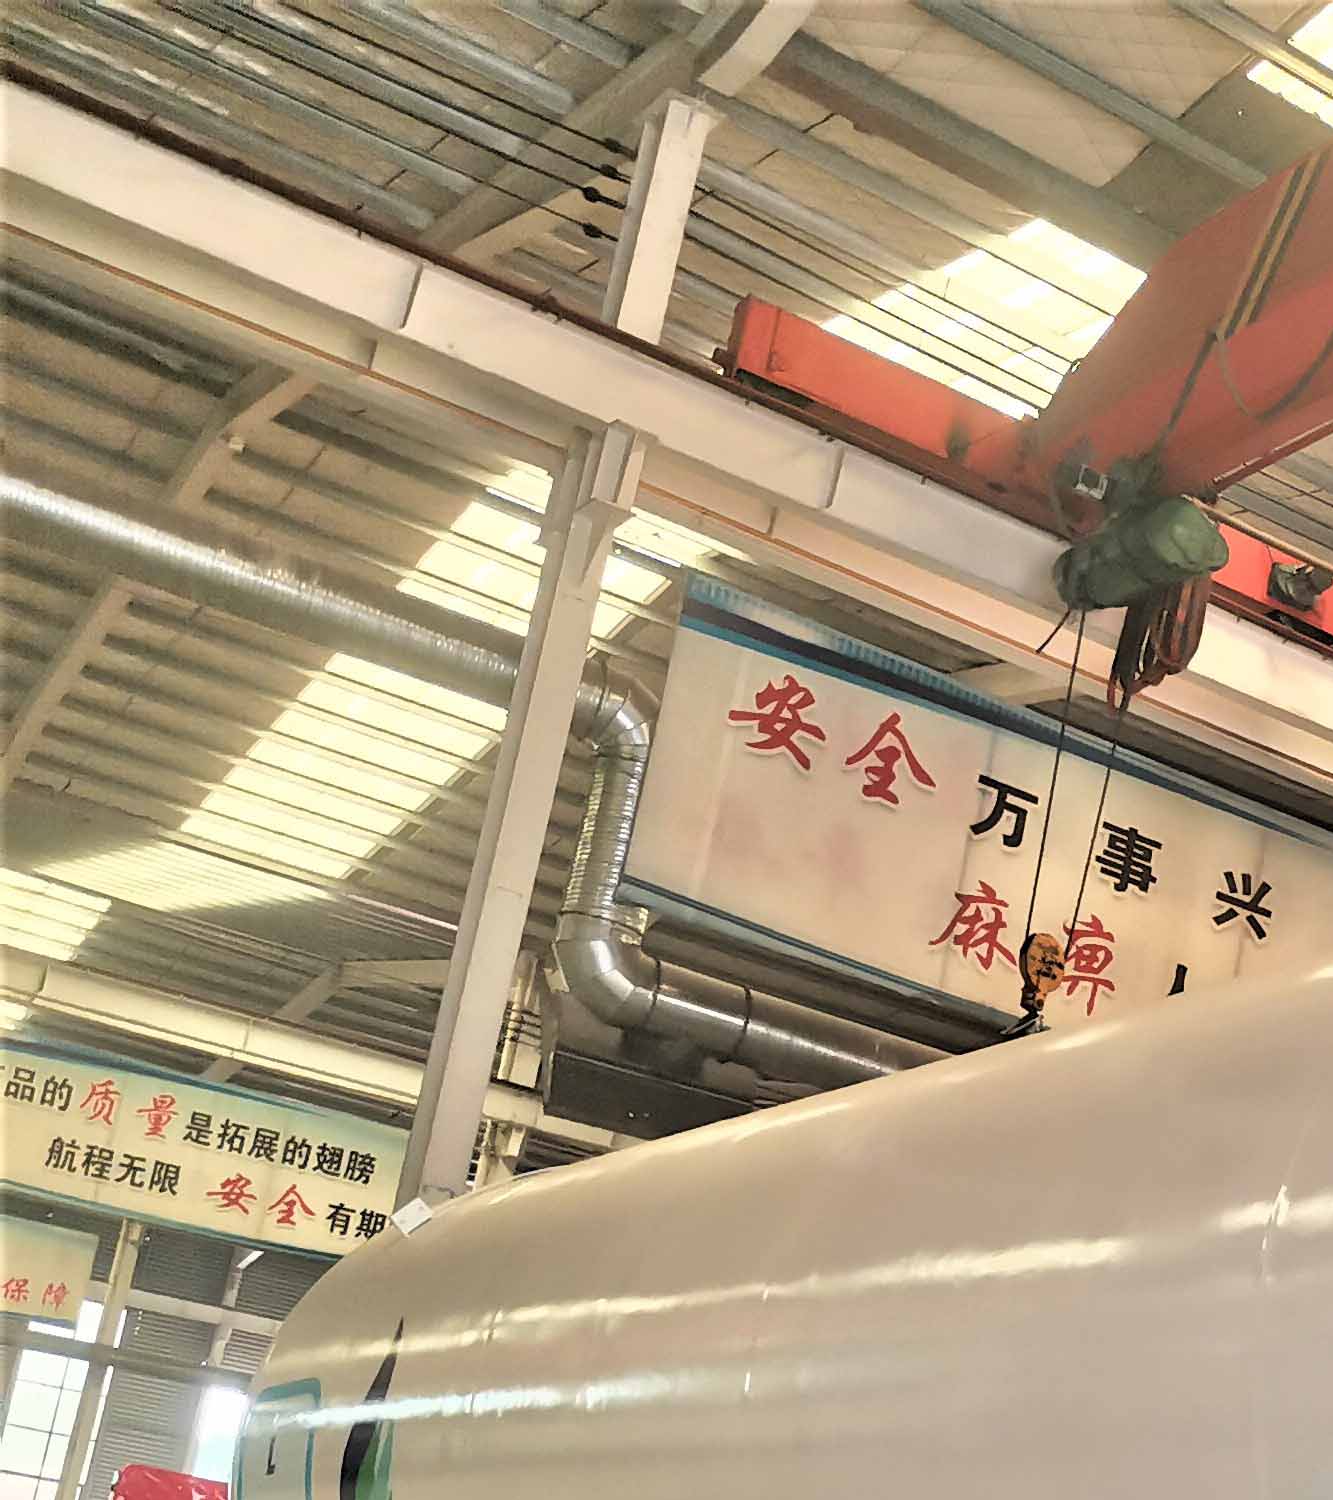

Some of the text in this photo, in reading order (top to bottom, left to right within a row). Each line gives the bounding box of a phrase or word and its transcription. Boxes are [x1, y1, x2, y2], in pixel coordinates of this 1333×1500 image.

[0, 1066, 377, 1185] 品的质量是拓展的翅膀
